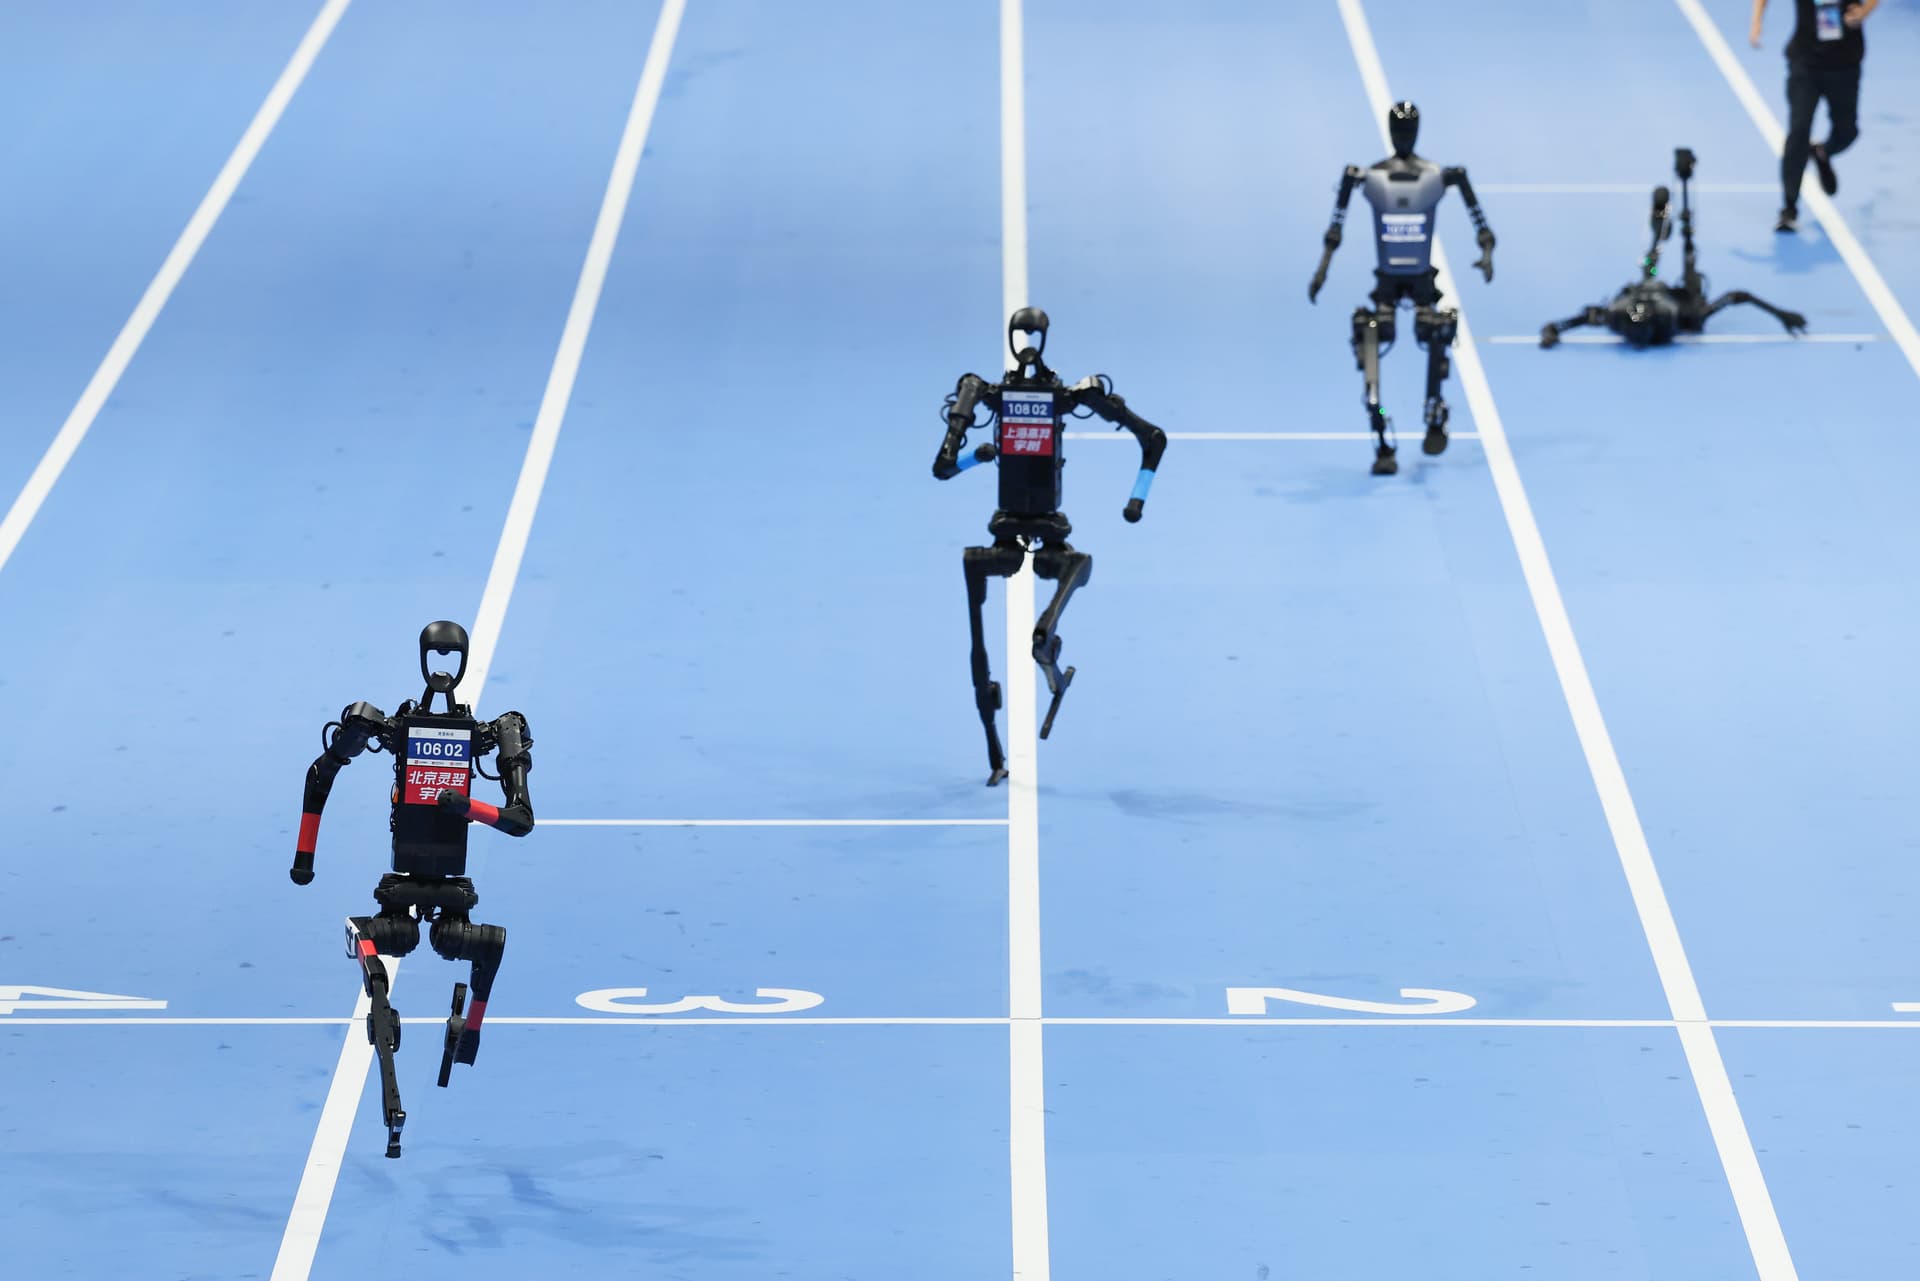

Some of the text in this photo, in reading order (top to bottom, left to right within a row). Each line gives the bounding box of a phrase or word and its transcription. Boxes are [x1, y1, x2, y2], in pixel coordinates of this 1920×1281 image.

[408, 770, 466, 787] 北京灵翌
[575, 987, 825, 1014] 3
[1226, 987, 1477, 1015] 2
